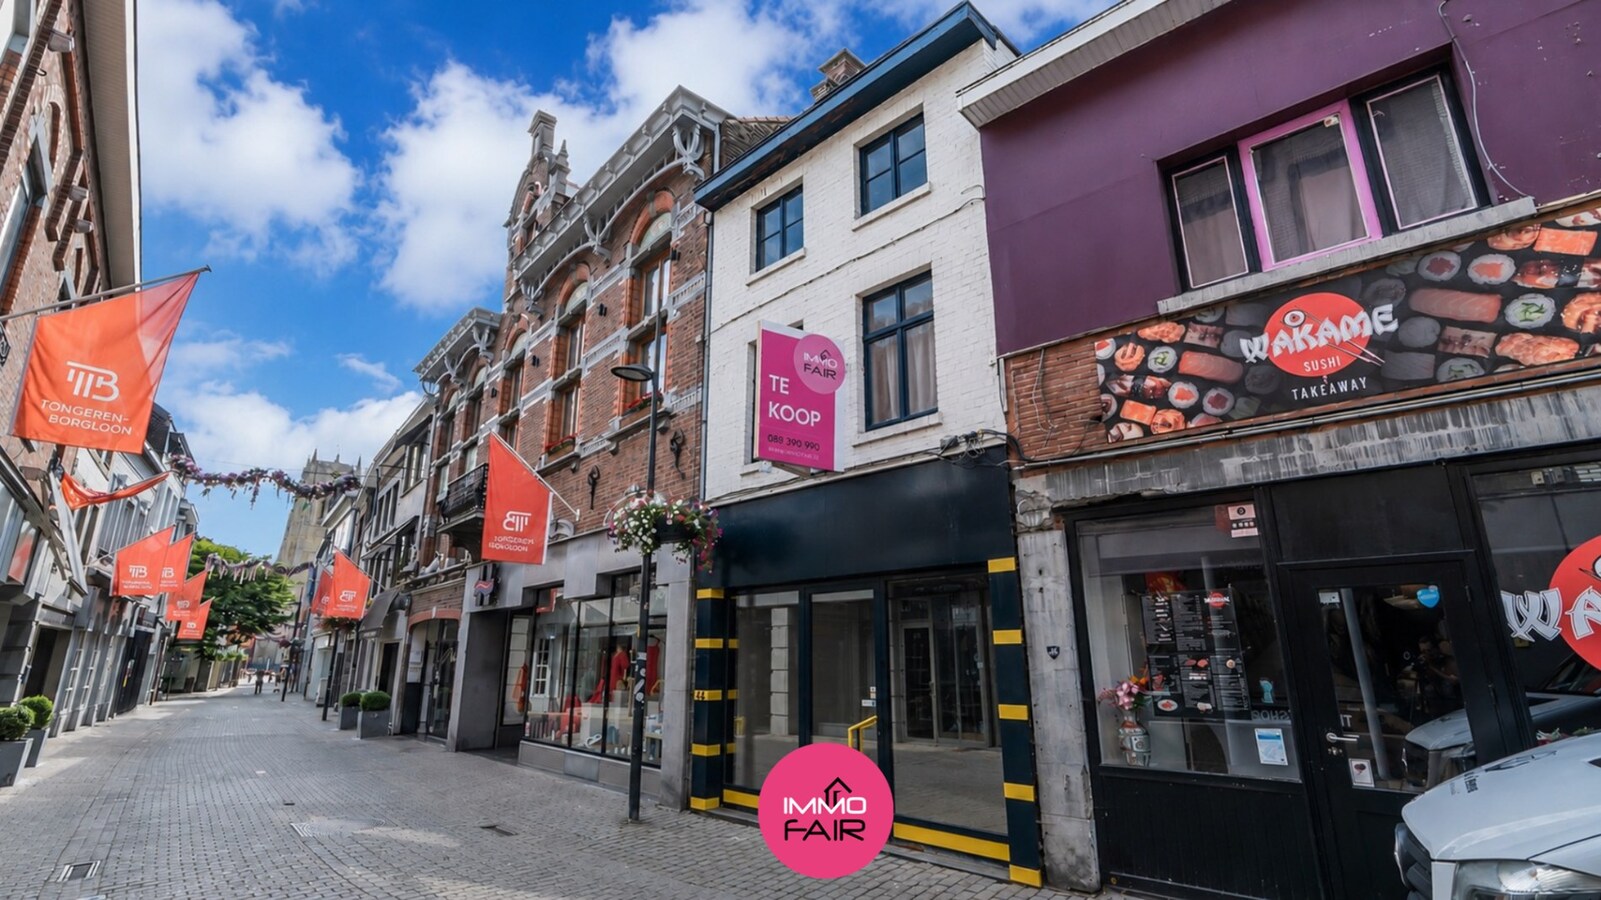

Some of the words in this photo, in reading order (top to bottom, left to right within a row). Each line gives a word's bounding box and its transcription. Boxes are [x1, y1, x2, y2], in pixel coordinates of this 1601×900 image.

[1239, 303, 1399, 364] WAKAME
[803, 352, 838, 369] IMMO
[1303, 355, 1342, 372] SUSHI
[803, 363, 837, 380] FAIR
[769, 374, 790, 395] TE
[1291, 377, 1368, 401] TAKEAWAY
[41, 399, 129, 423] TONGEREN-
[768, 401, 821, 427] KOOP
[48, 414, 133, 436] BORGLOON
[804, 441, 821, 452] 990
